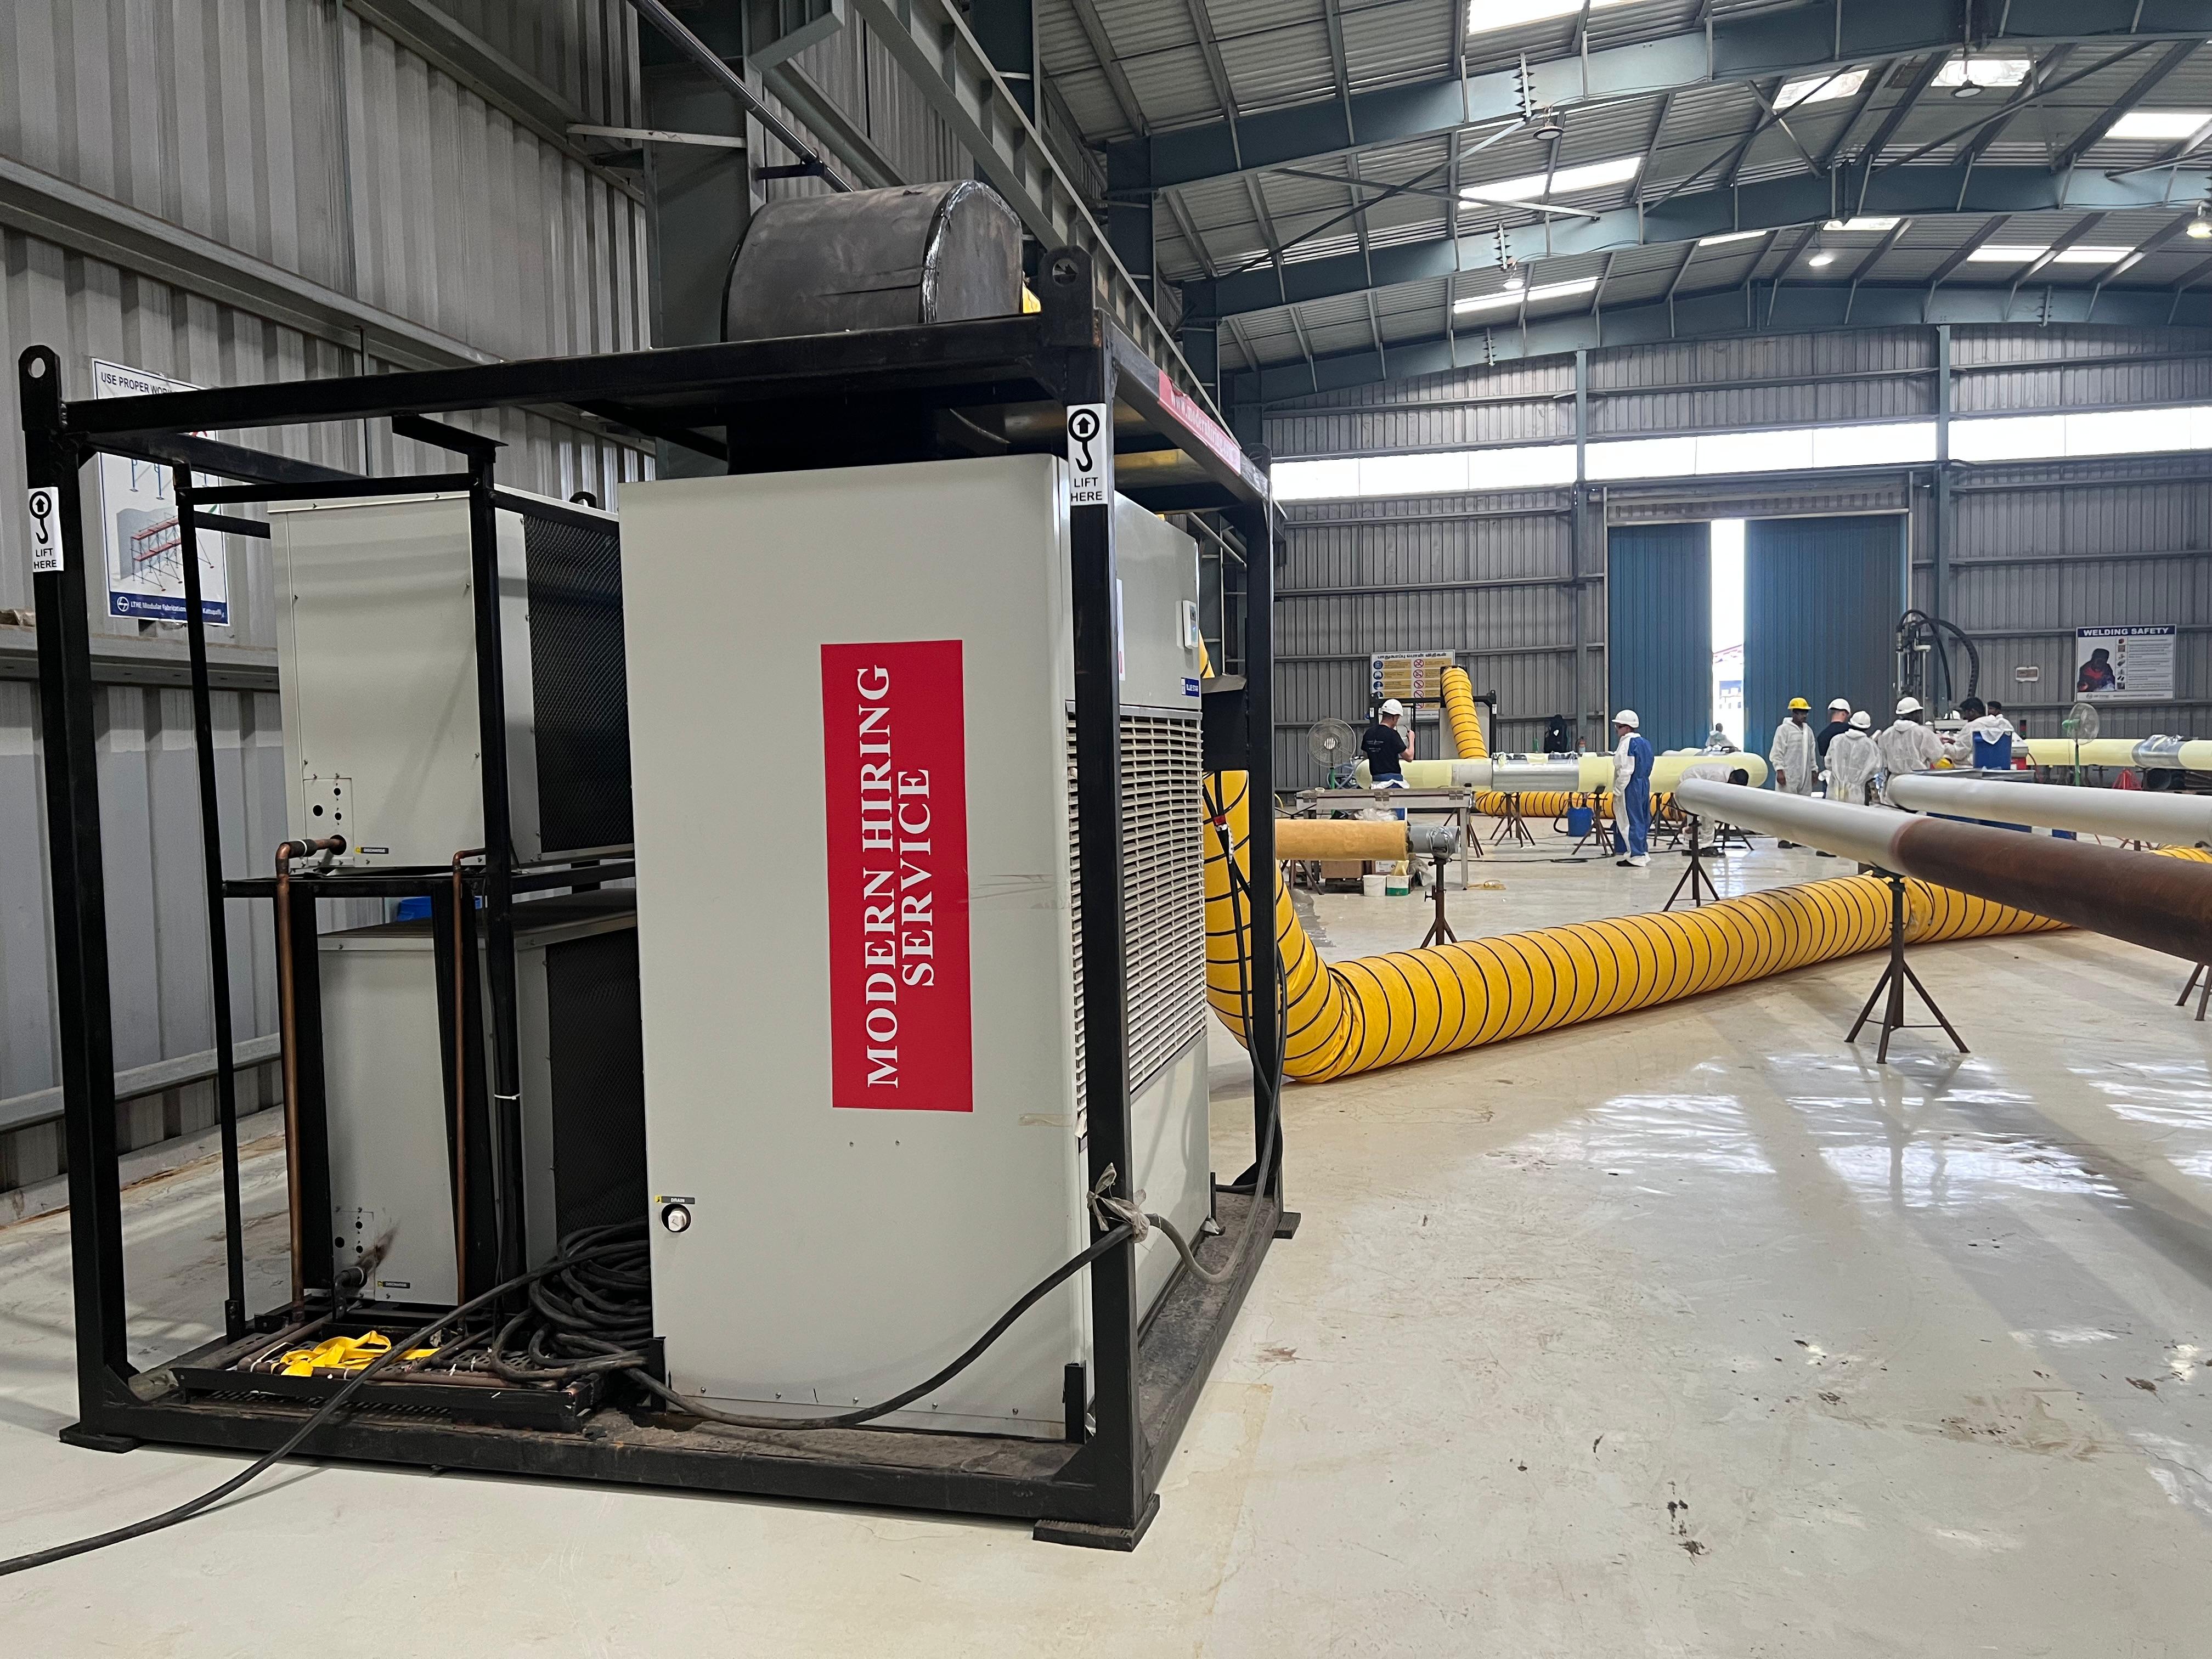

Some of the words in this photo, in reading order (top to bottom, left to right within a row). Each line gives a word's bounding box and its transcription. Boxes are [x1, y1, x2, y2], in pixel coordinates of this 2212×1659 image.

[101, 372, 117, 385] USE
[119, 377, 150, 394] PROPER
[1074, 477, 1098, 487] LIFT
[1070, 491, 1103, 502] HERE
[36, 548, 53, 557] LIFT
[33, 560, 57, 569] HERE
[857, 665, 893, 853] HIRING
[898, 769, 934, 986] SERVICE
[863, 867, 898, 1088] MODERN
